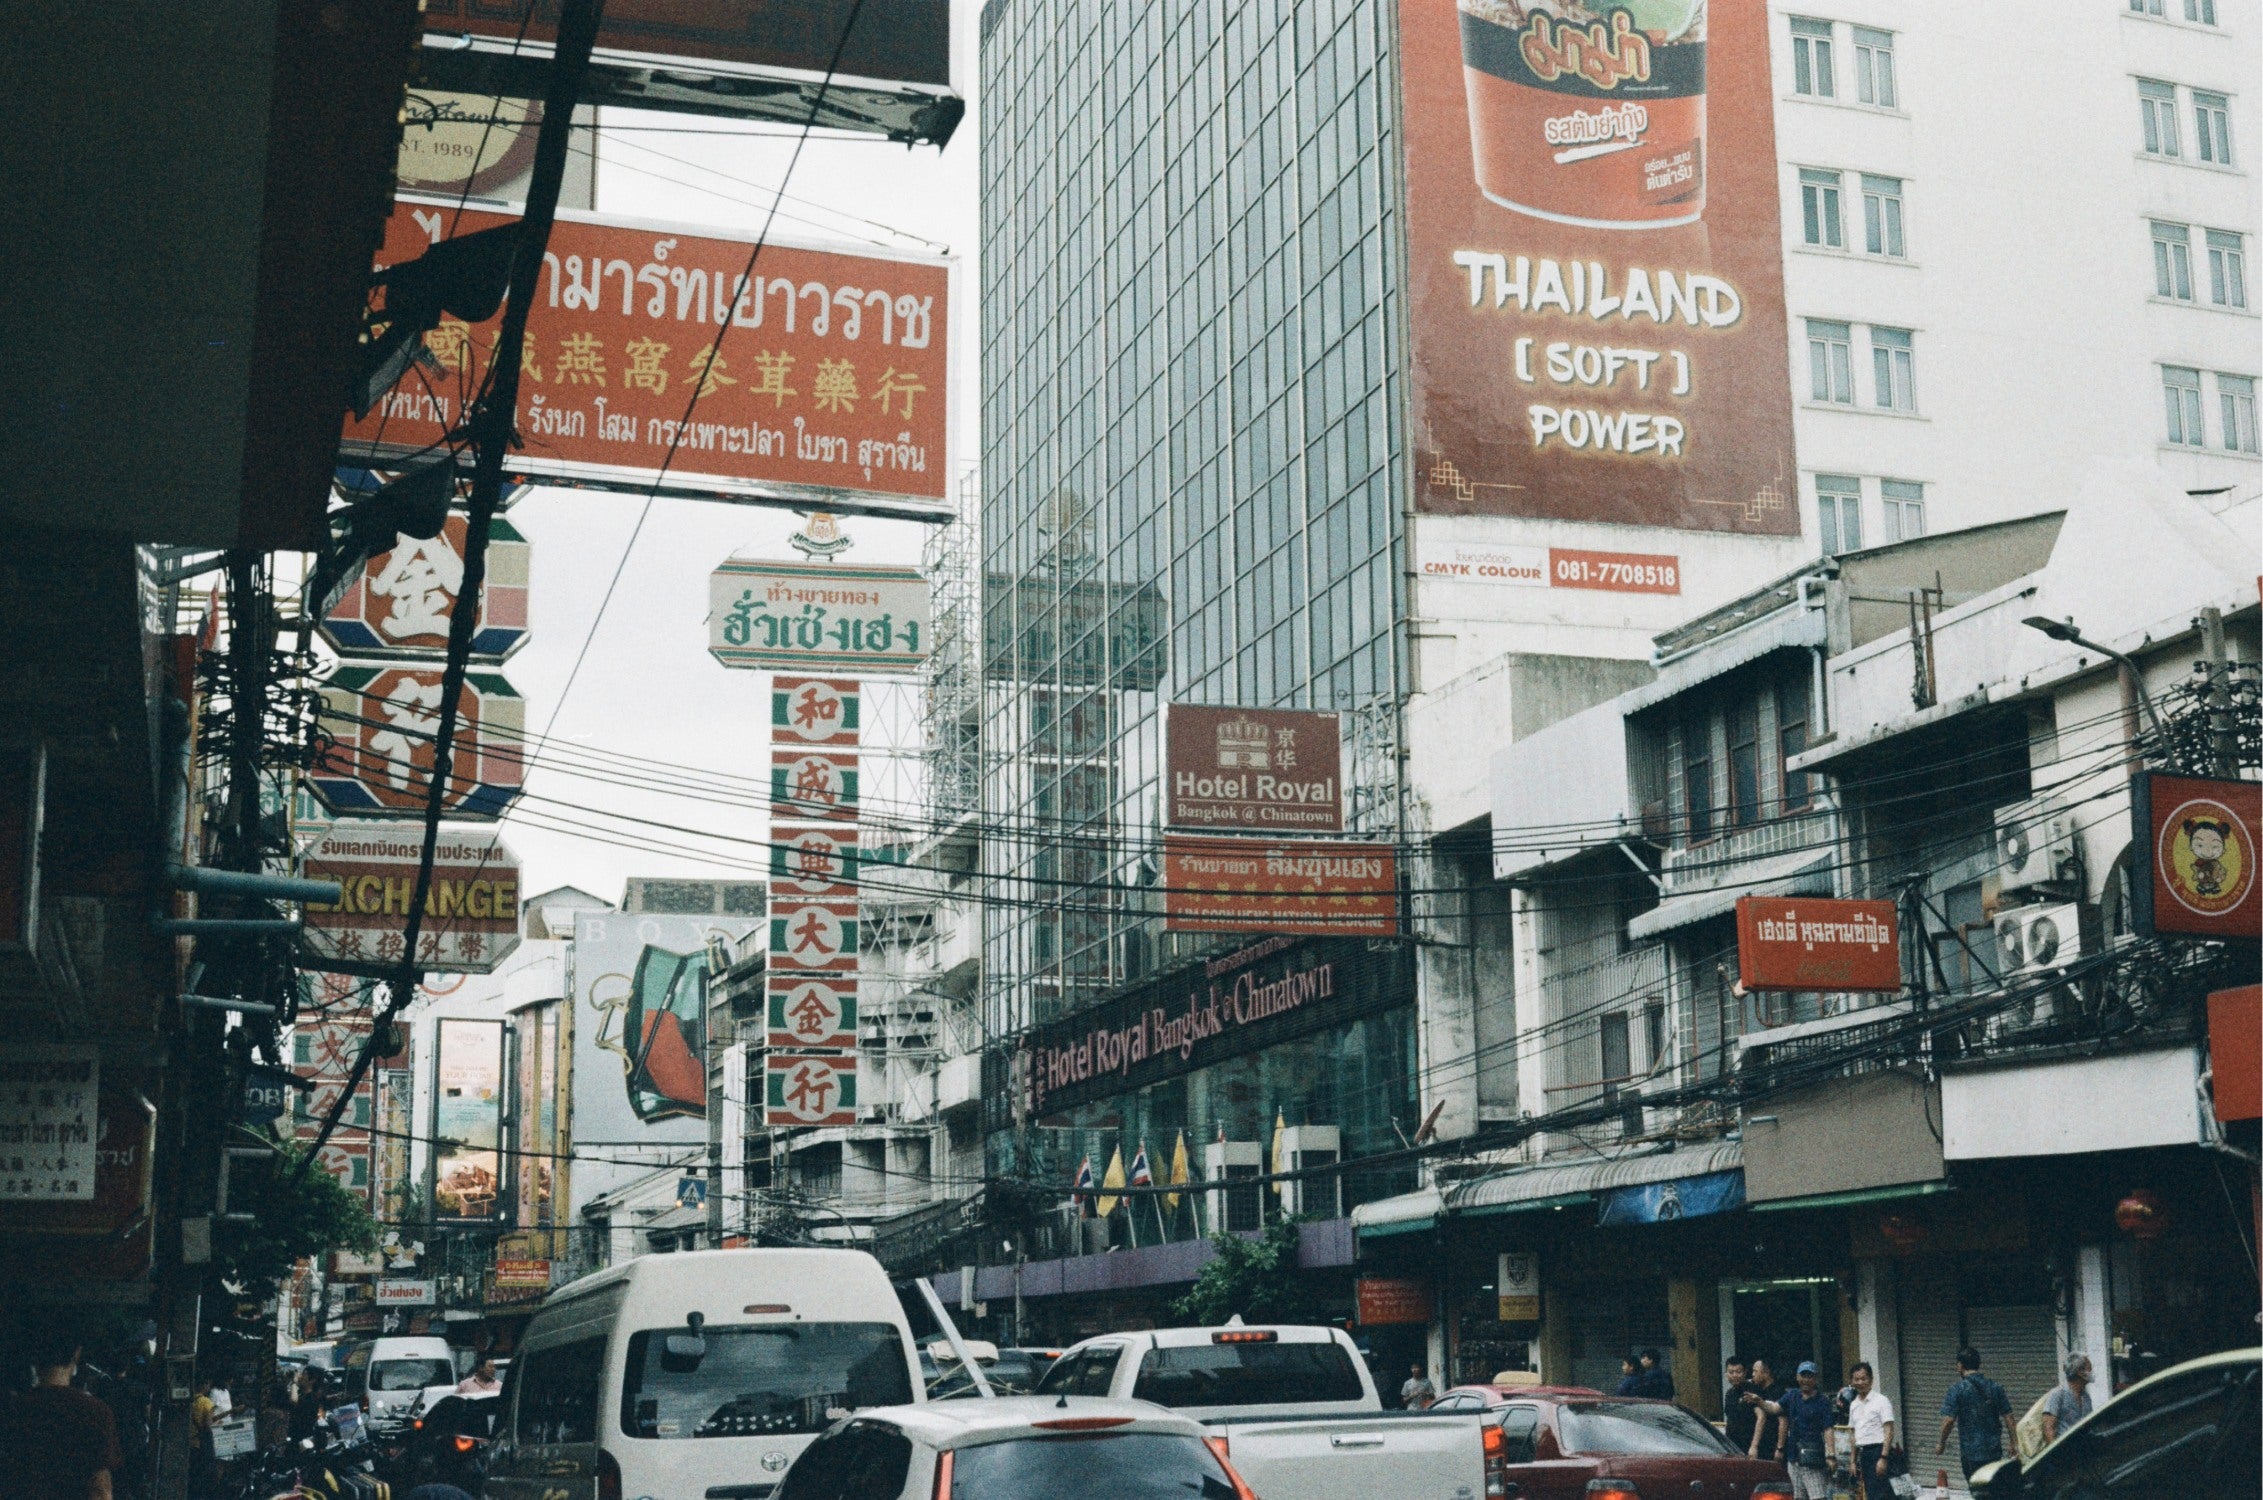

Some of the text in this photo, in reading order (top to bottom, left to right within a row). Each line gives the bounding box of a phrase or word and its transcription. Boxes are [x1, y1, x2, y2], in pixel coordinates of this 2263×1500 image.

[1545, 103, 1647, 144] รสต้มยำกุ้ง
[398, 140, 474, 158] ST. 1989
[1452, 250, 1741, 327] THAILAND
[1547, 342, 1659, 390] SOFT
[527, 393, 586, 438] รังนก
[594, 396, 637, 441] โสม
[647, 415, 785, 458] กระเพาะปลา
[793, 416, 848, 463] ใบชา
[857, 431, 926, 480] สุราจีน
[1528, 405, 1685, 456] POWER
[767, 581, 879, 606] ห้างขายทอง
[1425, 560, 1676, 586] CMYK COLOUR 081-7708518
[723, 589, 919, 652] ฮั่วเซ่งเฮง
[1274, 728, 1297, 771] 京华
[1176, 772, 1333, 804] Hotel Royal
[1177, 804, 1334, 824] Bangkok @ Chinatown
[1047, 1031, 1093, 1091] Hotel
[1097, 1011, 1149, 1076] Royal
[1152, 986, 1223, 1060] Bangkok
[1233, 962, 1335, 1026] Chinatown
[244, 1086, 282, 1107] OB
